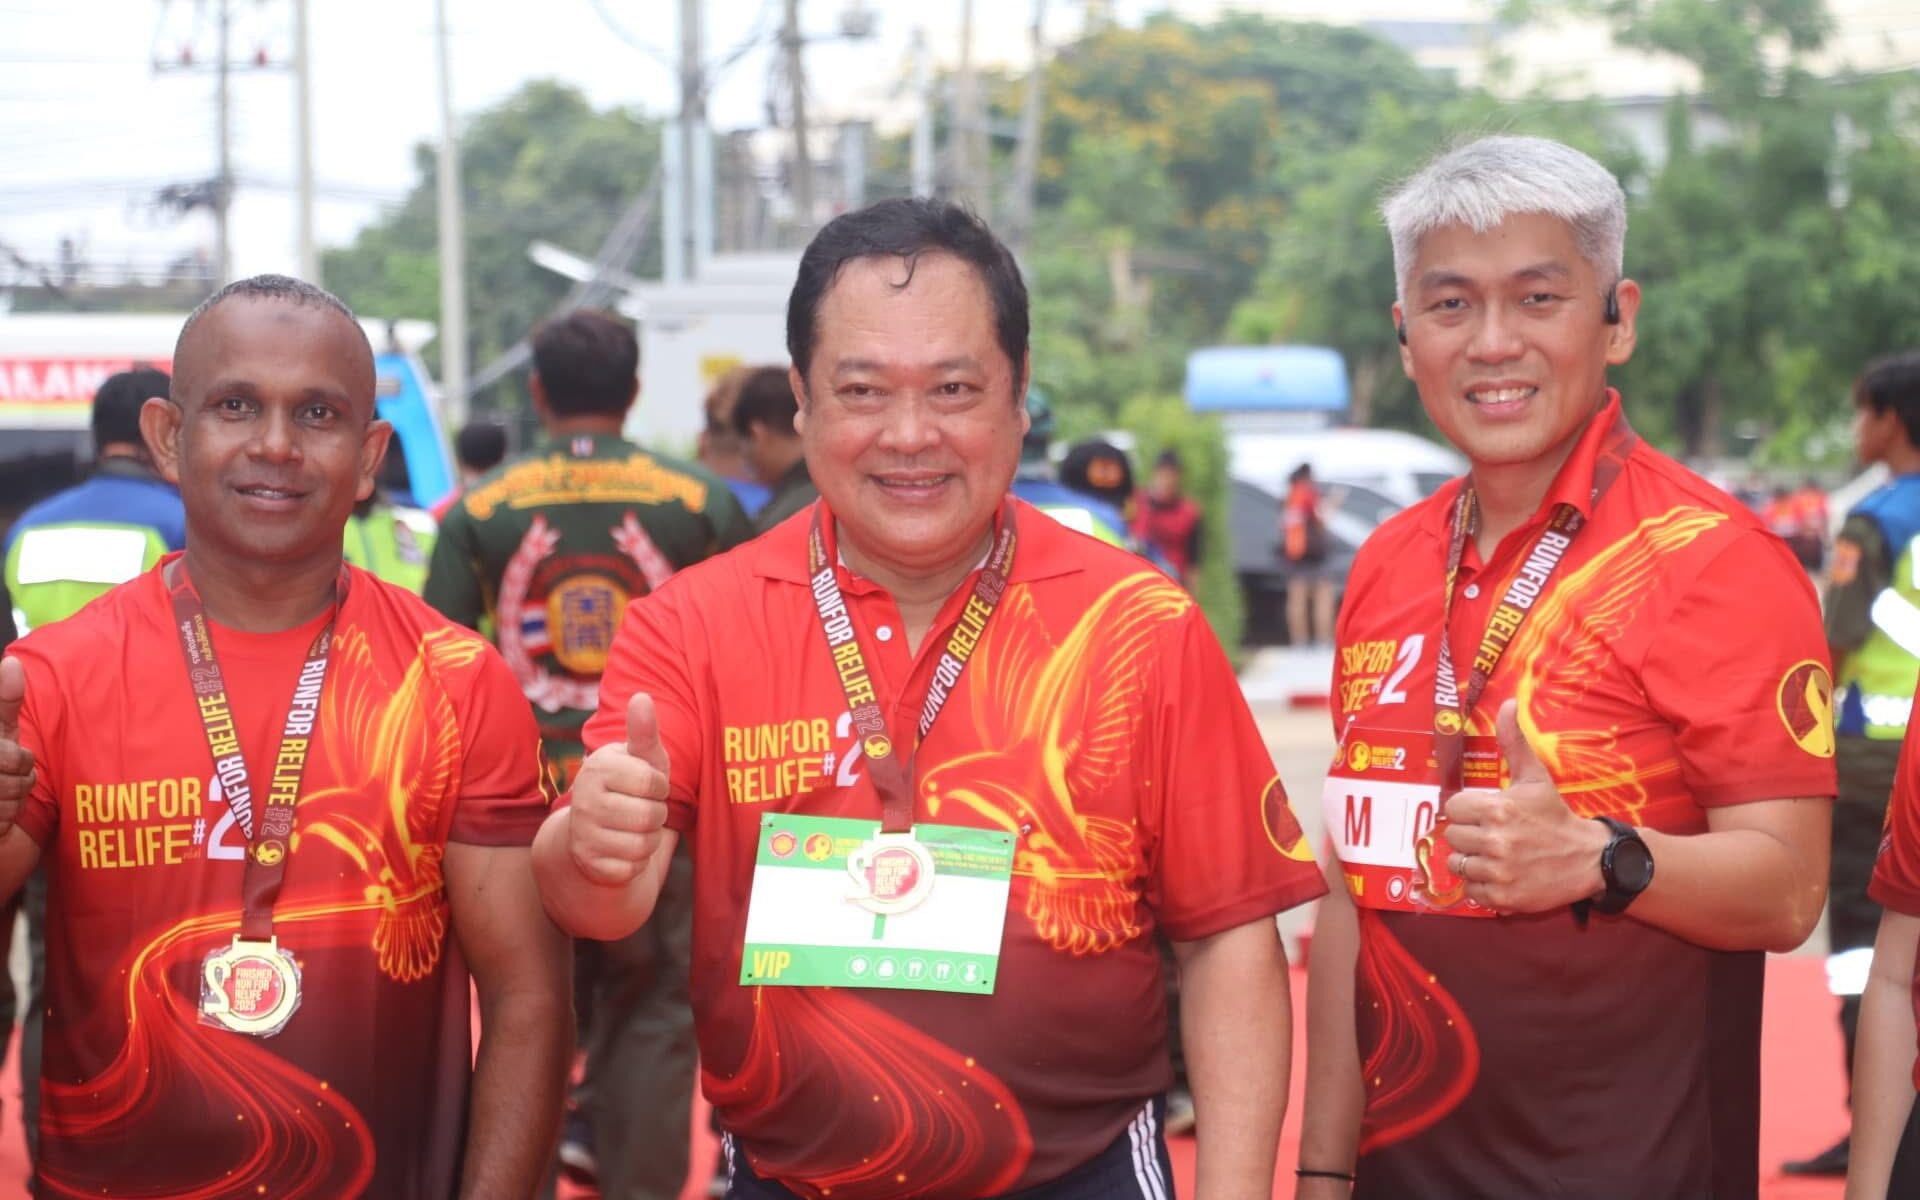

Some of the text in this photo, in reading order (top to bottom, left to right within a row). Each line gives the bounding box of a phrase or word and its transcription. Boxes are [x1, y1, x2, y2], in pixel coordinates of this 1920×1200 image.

[1503, 531, 1571, 609] RUNFOR
[811, 567, 855, 646] RUNFOR
[833, 641, 876, 709] RELIFE
[919, 653, 963, 736] RUNFOR
[946, 594, 993, 662] RELIFE
[1473, 604, 1525, 675] RELIFE
[198, 692, 241, 758] RELIFE
[283, 658, 328, 736] RUNFOR
[267, 738, 308, 806] RELIFE
[723, 717, 831, 763] RUNFOR
[75, 777, 201, 824] RUNFOR
[725, 756, 823, 805] RELIFE
[78, 824, 193, 869] RELIFE
[1344, 794, 1373, 848] M
[752, 951, 791, 979] VIP
